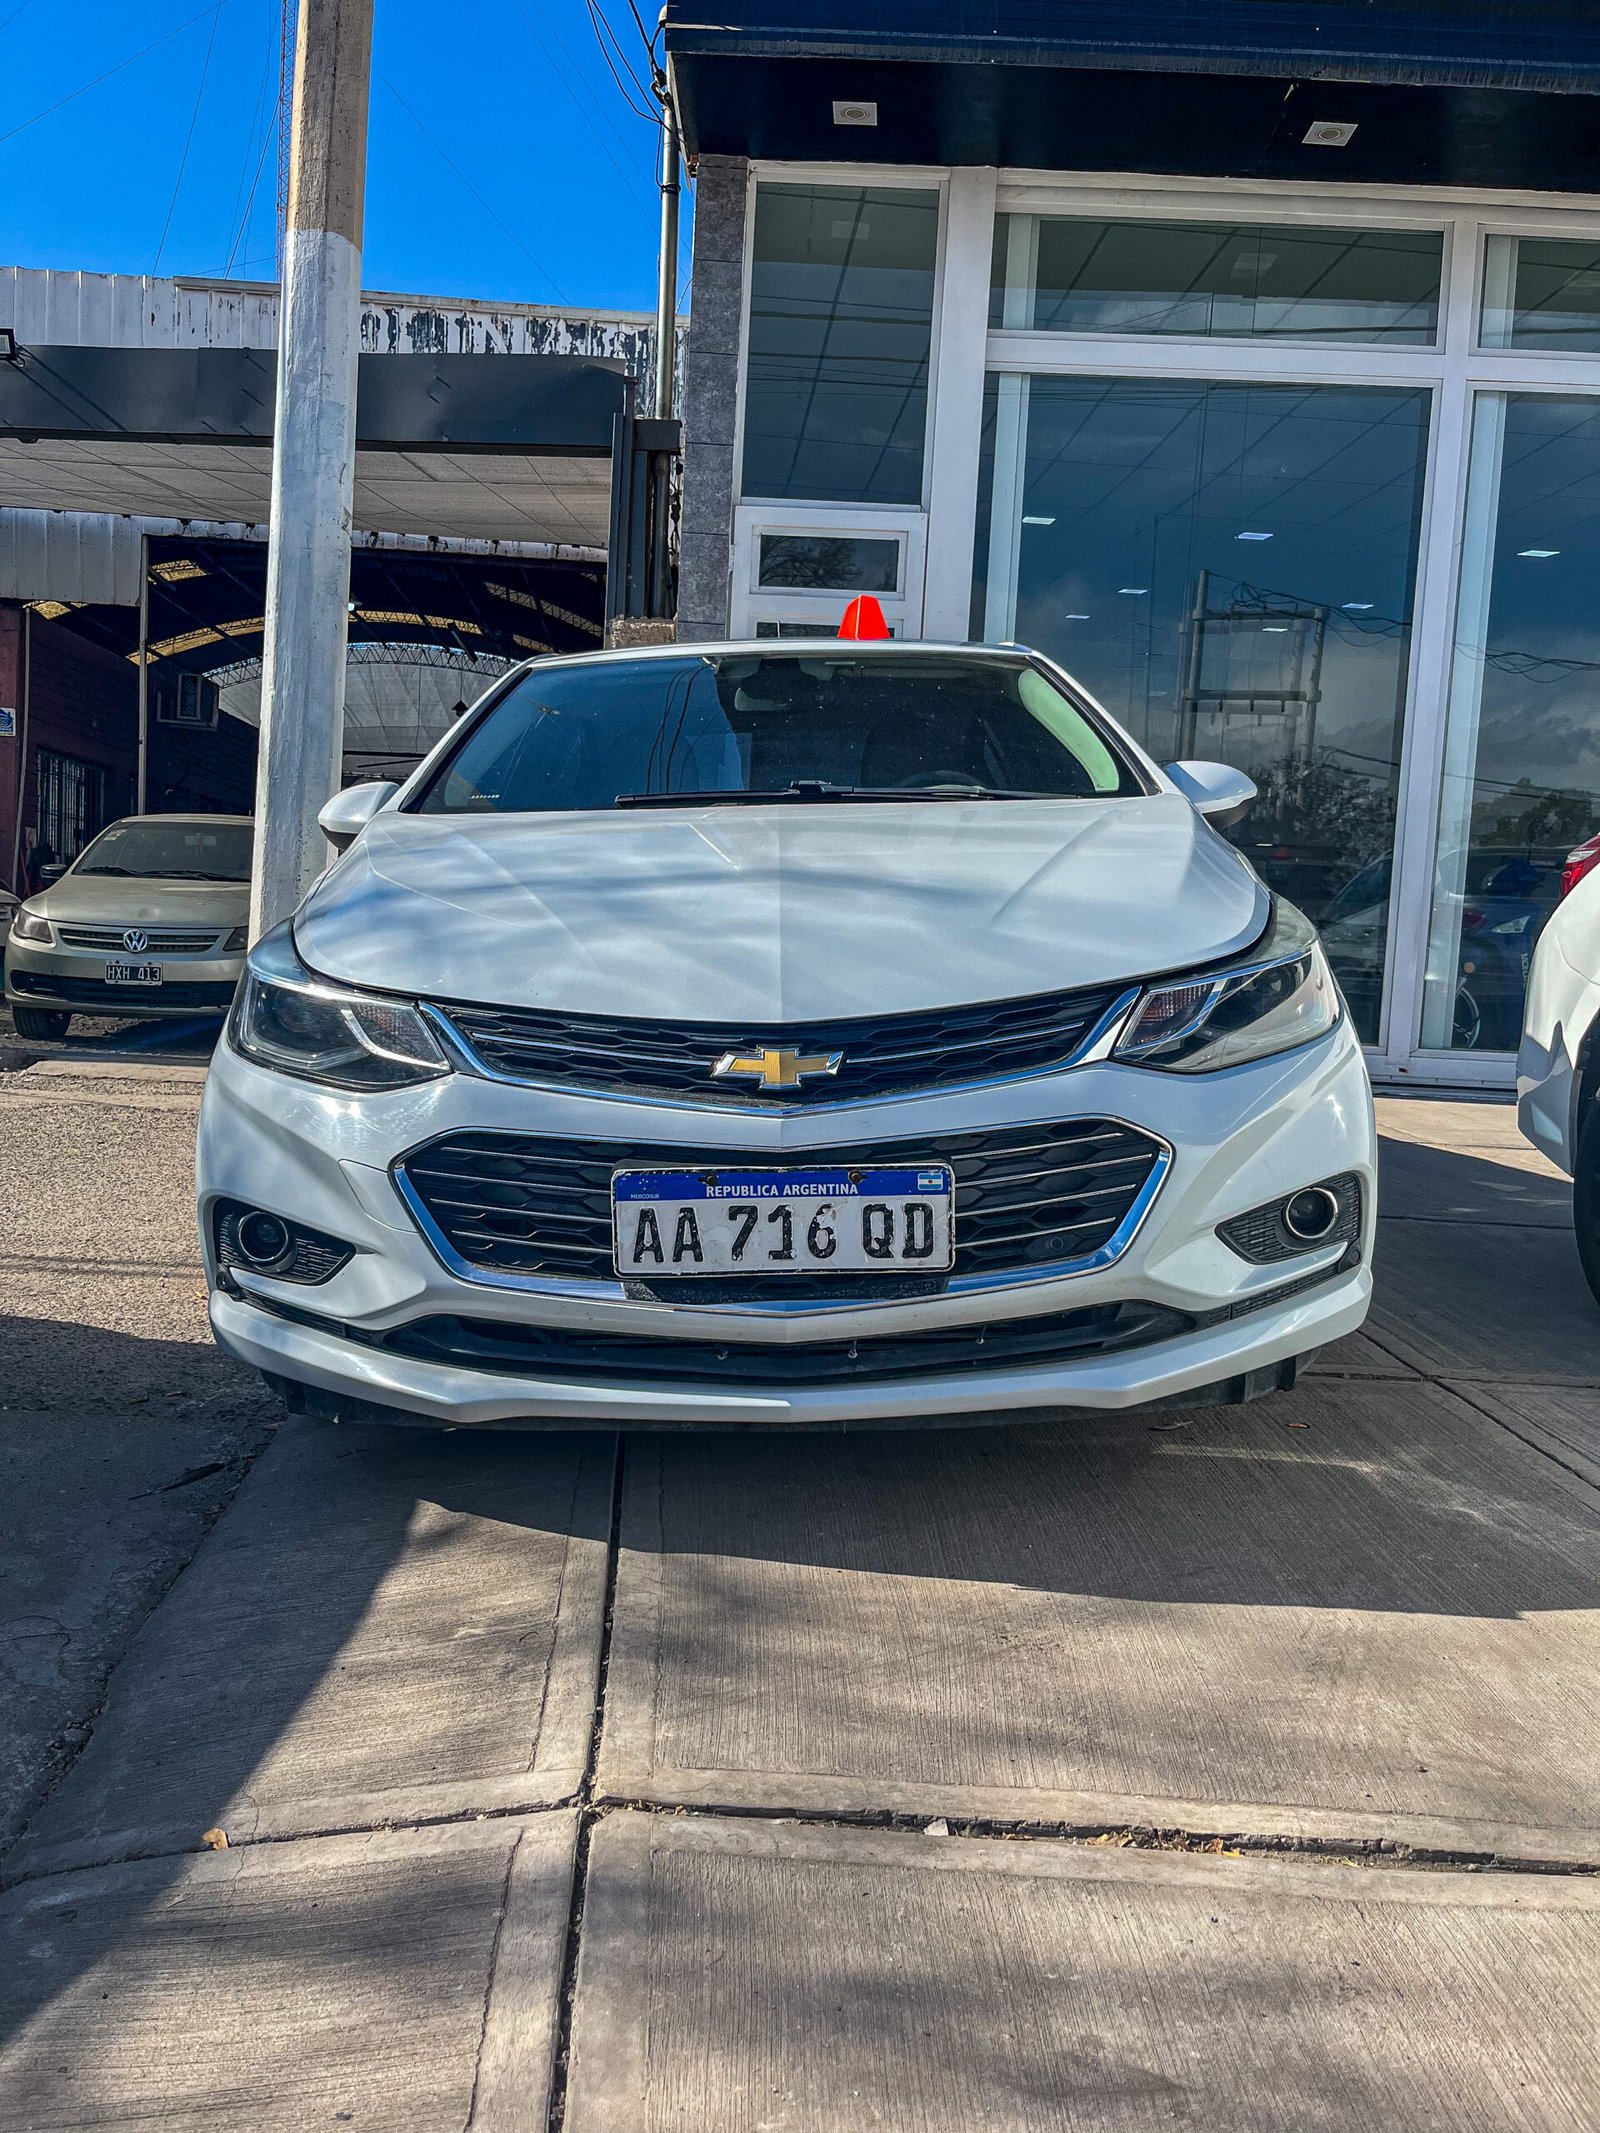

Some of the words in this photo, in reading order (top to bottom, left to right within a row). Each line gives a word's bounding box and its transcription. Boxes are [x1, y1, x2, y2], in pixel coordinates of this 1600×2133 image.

[107, 966, 130, 980] HXH
[137, 967, 160, 981] 413
[706, 1185, 778, 1198] REPUBLICA
[783, 1183, 859, 1196] ARGENTINA
[633, 1207, 704, 1263] AA
[728, 1203, 837, 1261] 716
[862, 1202, 934, 1259] QD
